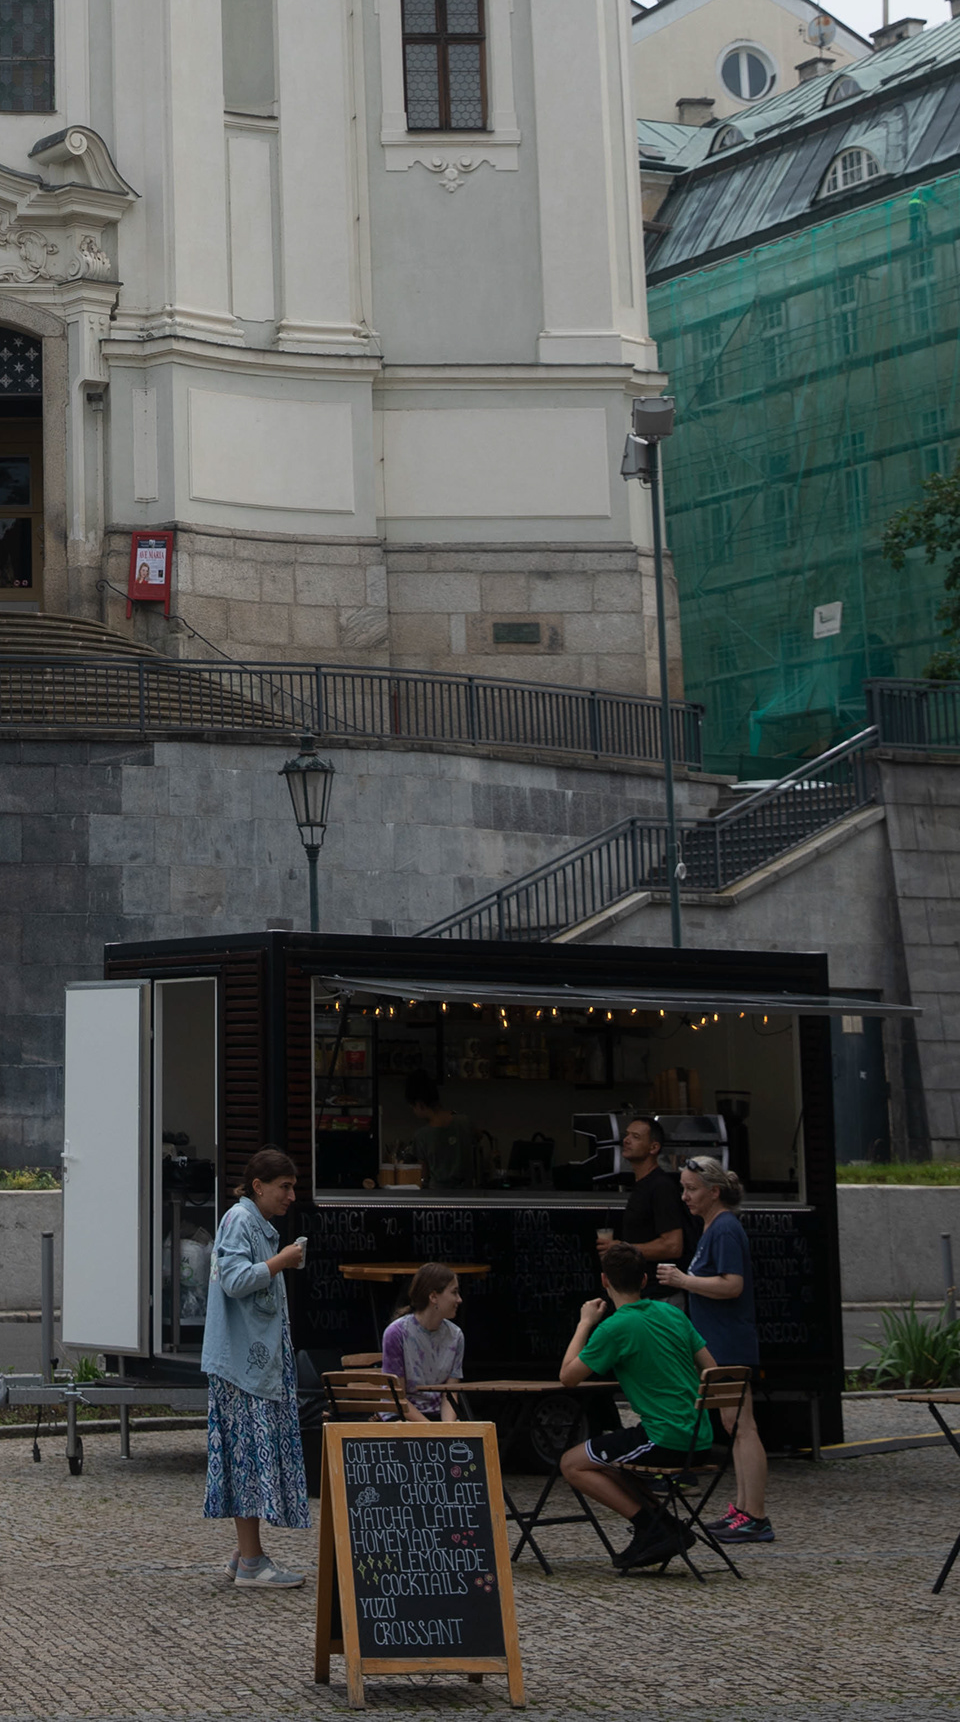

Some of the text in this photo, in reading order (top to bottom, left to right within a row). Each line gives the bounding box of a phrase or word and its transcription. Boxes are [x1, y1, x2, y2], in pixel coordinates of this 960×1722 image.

[412, 1210, 474, 1232] MATCHA
[345, 1441, 447, 1463] COFFEE TO GO
[345, 1463, 446, 1484] HOT AND ICED
[400, 1482, 486, 1505] CHOCOLATE
[349, 1505, 479, 1530] MATCHA LATTE
[352, 1529, 447, 1554] HOMEMADE
[398, 1548, 489, 1572] LEMONADE
[380, 1572, 469, 1596] COCKTAILS
[360, 1597, 396, 1618] YUZU
[373, 1619, 464, 1645] CROISSANT
